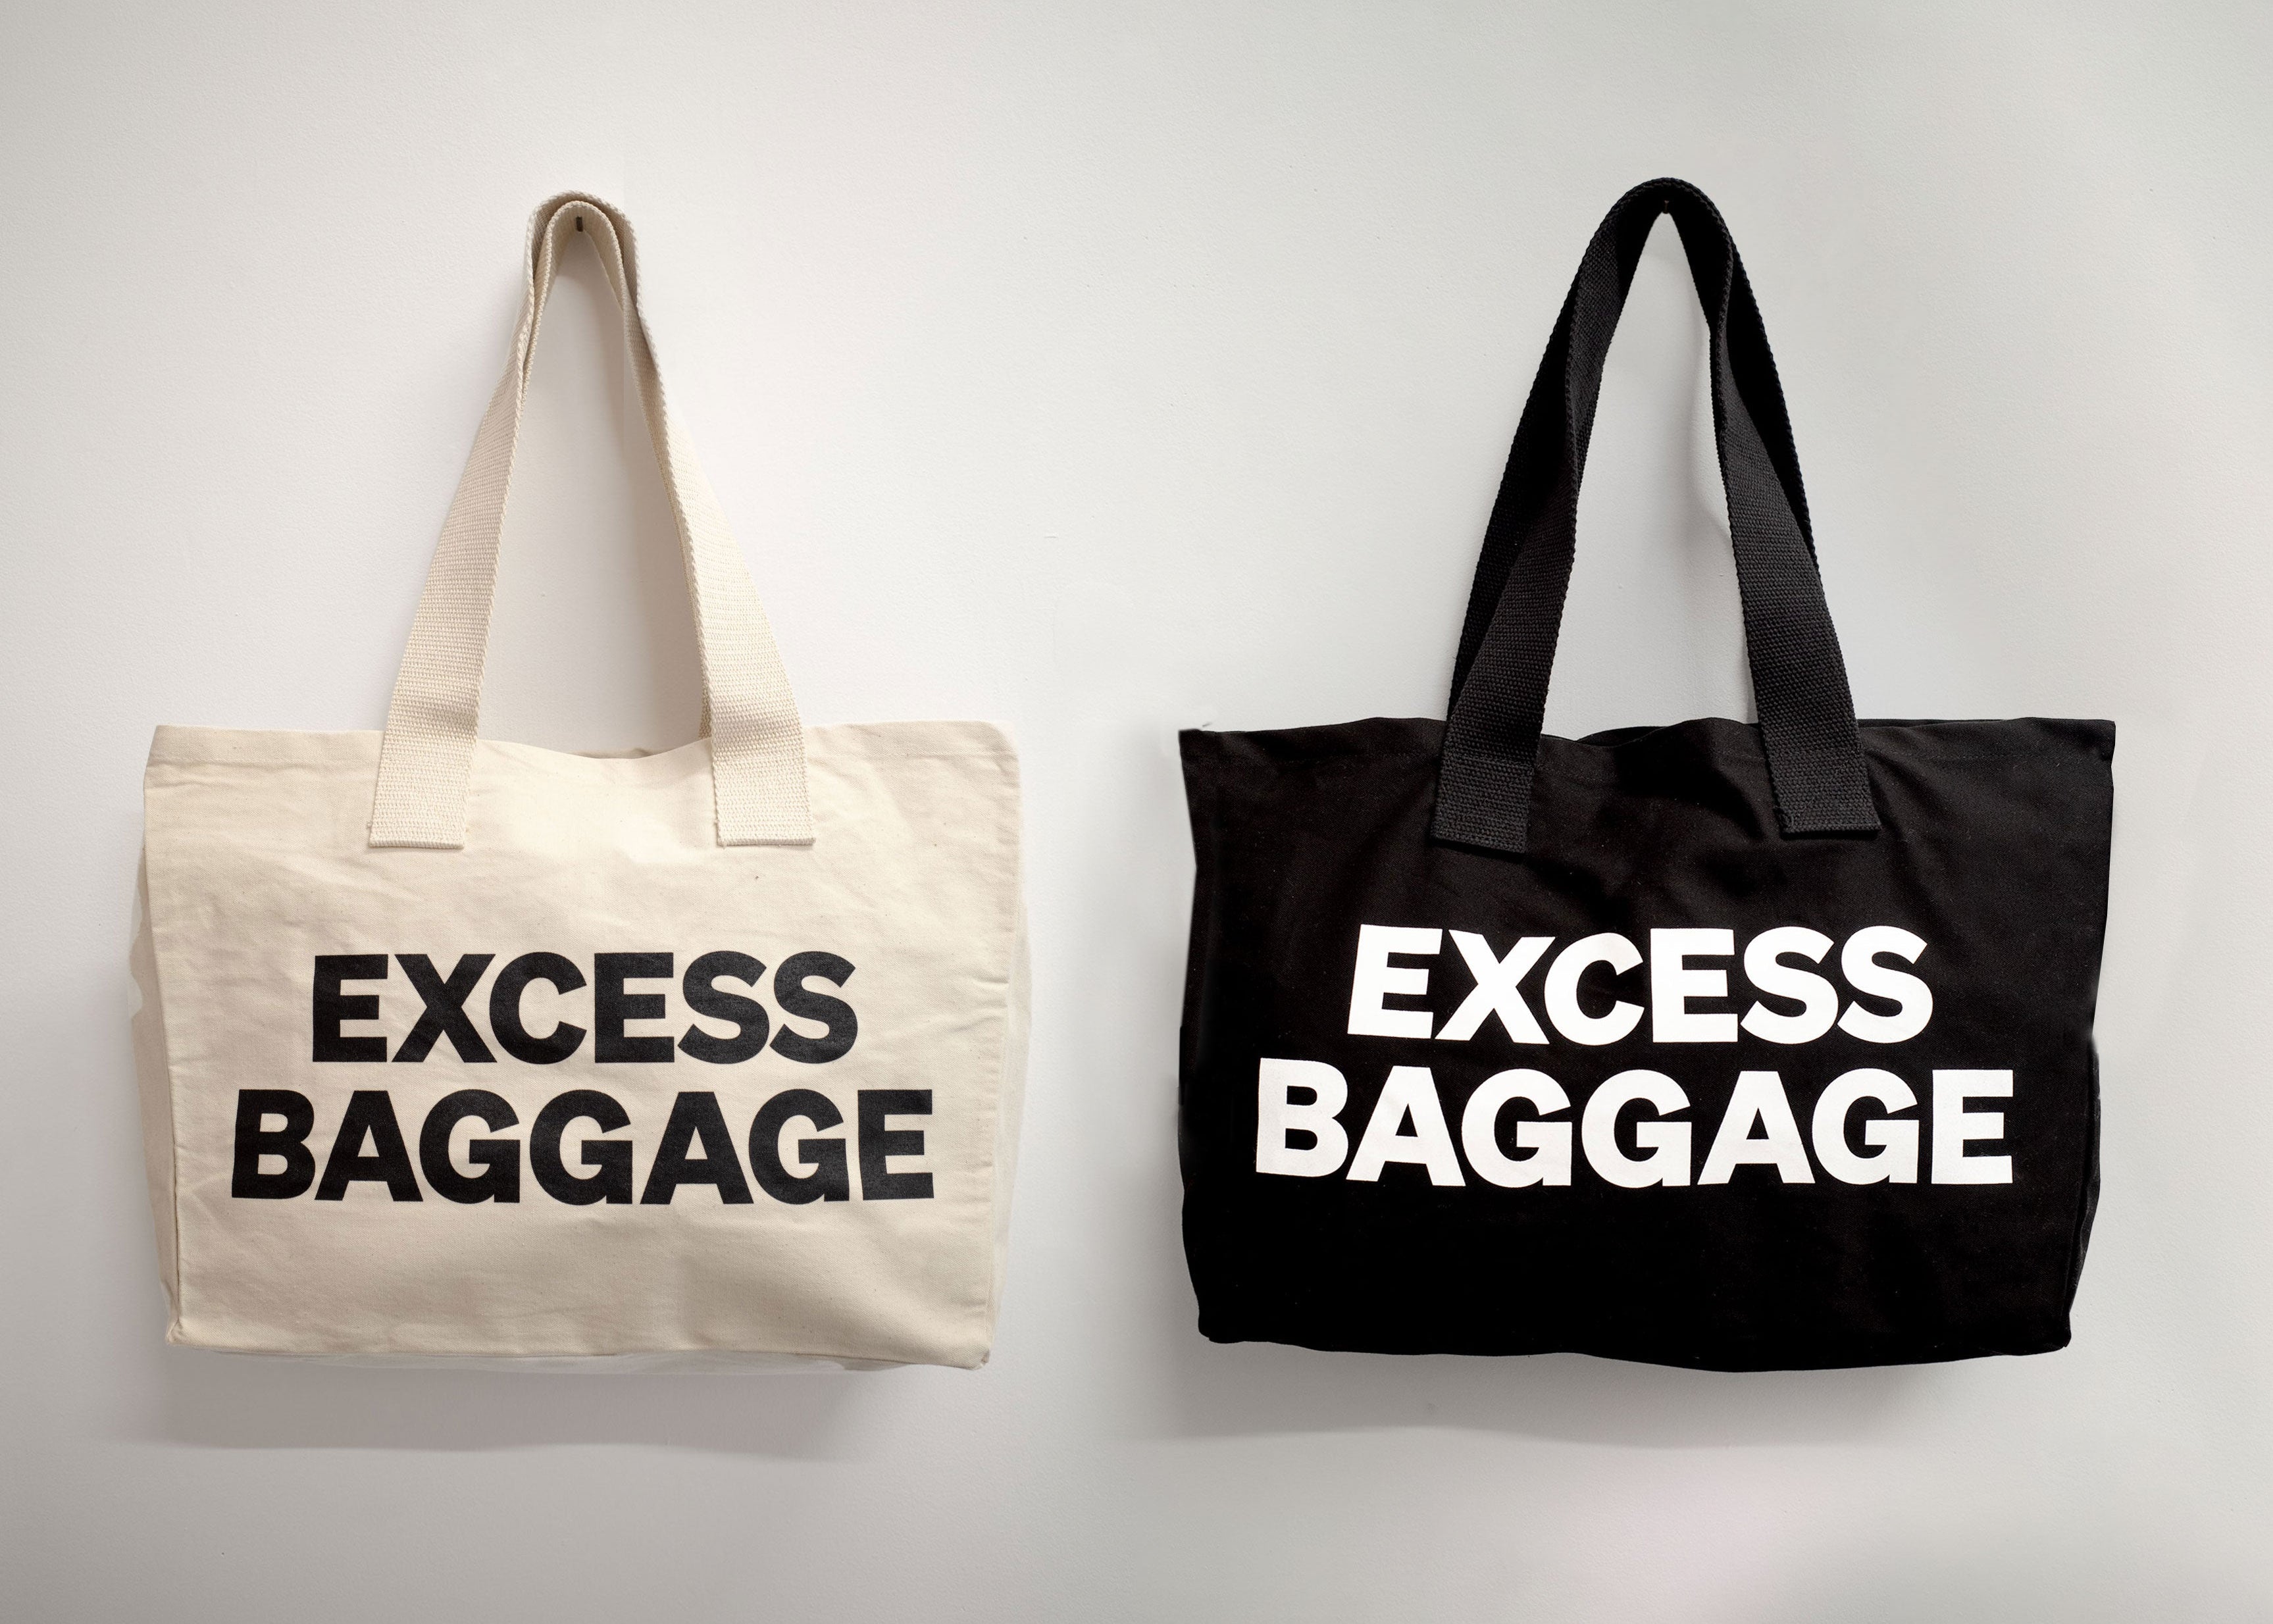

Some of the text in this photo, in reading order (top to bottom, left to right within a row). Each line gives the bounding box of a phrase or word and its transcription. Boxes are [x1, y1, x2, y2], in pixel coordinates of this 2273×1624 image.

[313, 952, 857, 1064] EXCESS
[1348, 925, 1933, 1046] EXCESS
[232, 1089, 934, 1205] BAGGAGE
[1256, 1058, 2013, 1188] BAGGAGE
